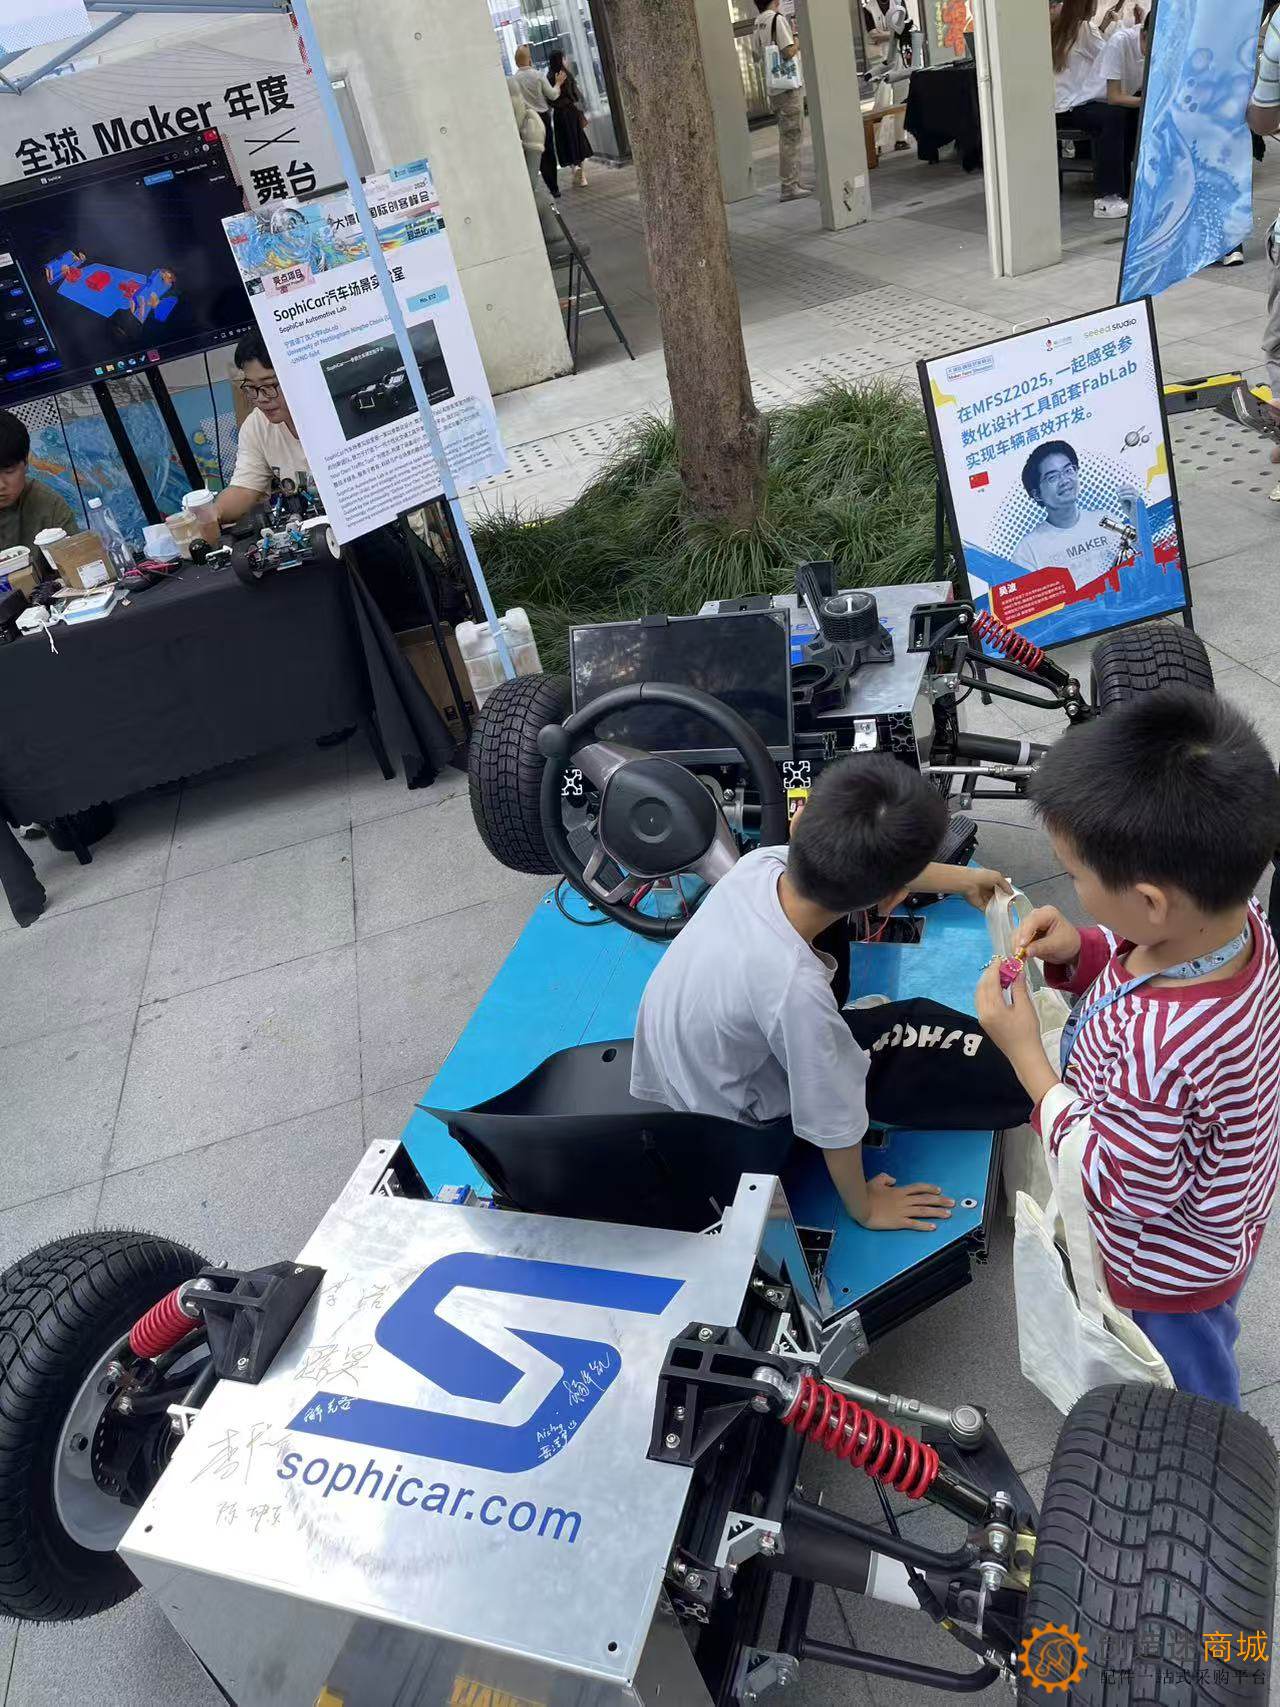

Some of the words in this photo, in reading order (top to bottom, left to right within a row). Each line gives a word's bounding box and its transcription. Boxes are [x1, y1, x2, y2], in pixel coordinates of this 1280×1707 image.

[15, 127, 86, 175] 全球
[92, 98, 215, 157] Maker
[223, 74, 295, 123] 年度
[251, 159, 316, 205] 舞台
[331, 189, 430, 231] 大湾国际创客峰会
[271, 265, 406, 325] SophiCar汽车场景实室
[278, 319, 305, 334] SophiCar
[304, 308, 336, 325] Automotive
[335, 304, 347, 313] Lab
[1112, 318, 1137, 332] studio
[961, 360, 1138, 448] 数化设计工具配套FabLab
[965, 408, 1095, 470] 实现车辆高效开发。
[1066, 535, 1109, 558] MAKER
[277, 1449, 583, 1544] sophicar.com
